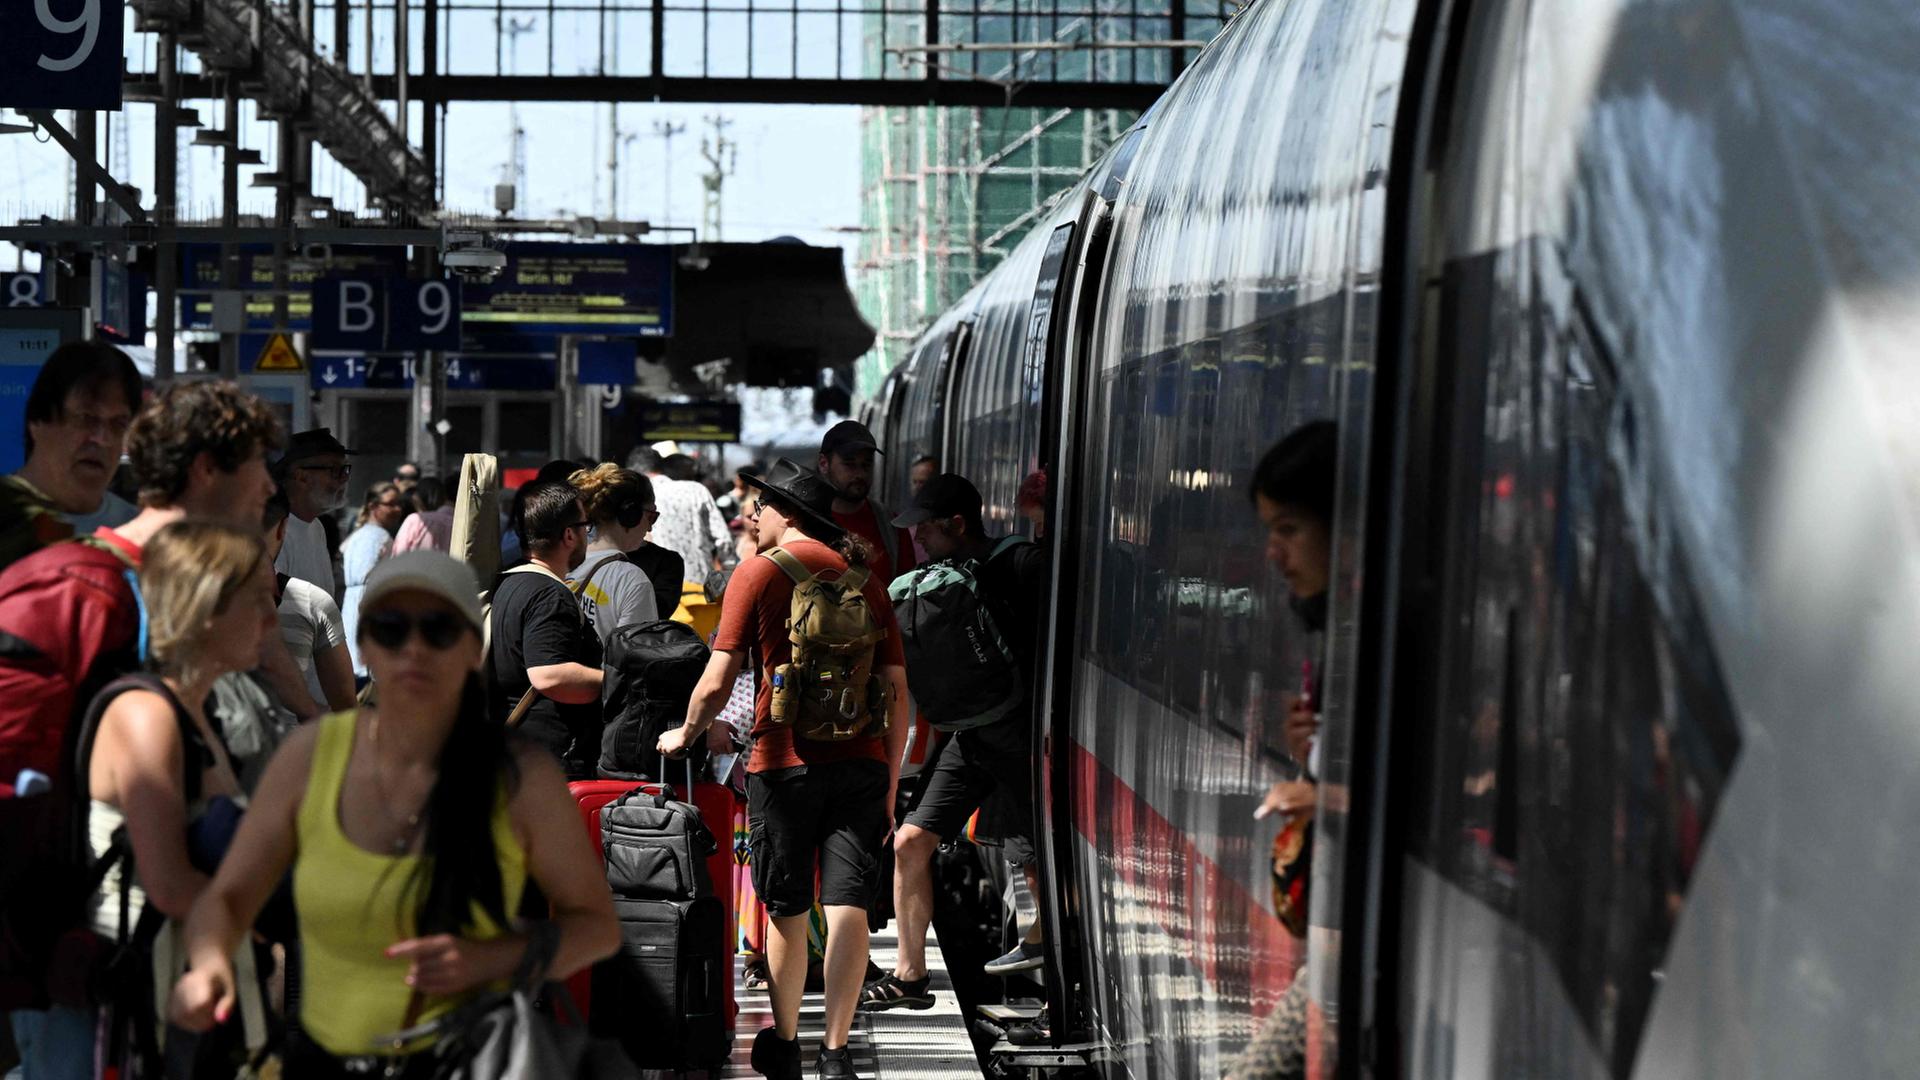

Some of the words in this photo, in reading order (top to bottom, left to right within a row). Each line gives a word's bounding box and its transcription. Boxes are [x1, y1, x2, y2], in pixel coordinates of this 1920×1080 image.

[34, 0, 101, 71] 9
[9, 273, 40, 307] 8
[339, 280, 376, 333] B
[417, 280, 452, 335] 9
[19, 340, 48, 351] 11:11
[343, 357, 380, 380] 1-7
[446, 358, 462, 381] 4
[0, 381, 26, 396] ain
[602, 383, 622, 410] 9
